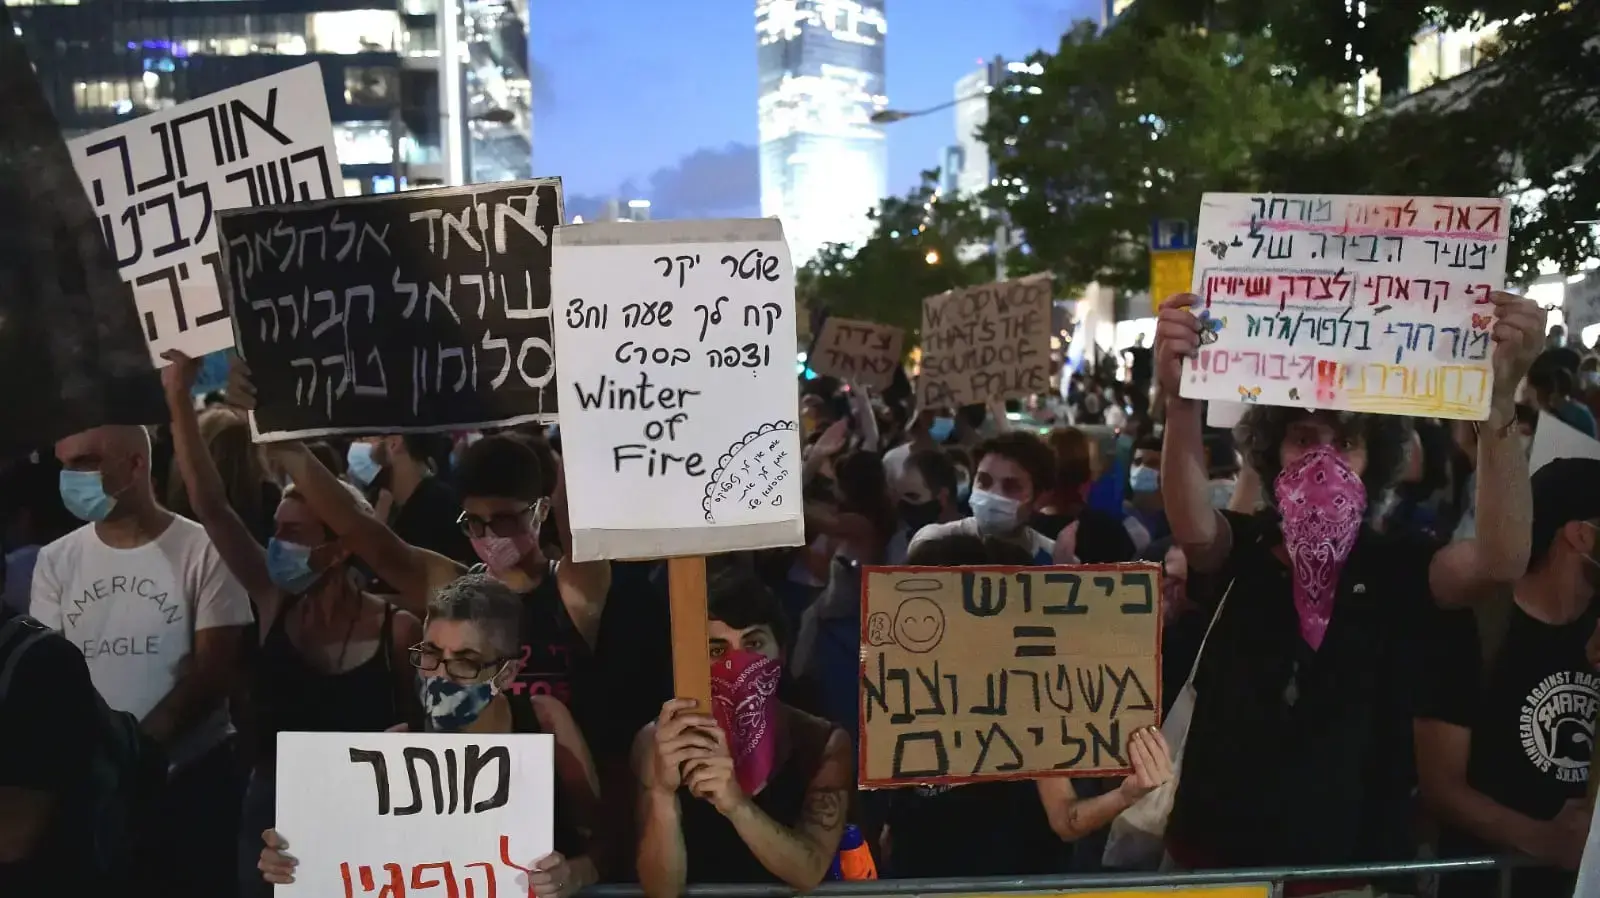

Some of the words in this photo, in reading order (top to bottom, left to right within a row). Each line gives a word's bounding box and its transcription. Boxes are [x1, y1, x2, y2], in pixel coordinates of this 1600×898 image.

[86, 87, 294, 206] אוחנה
[1251, 197, 1332, 228] מורחק
[1433, 204, 1502, 232] גאה
[230, 209, 391, 302] אלחלאק
[1309, 232, 1403, 262] הבירה
[654, 254, 701, 288] יקר
[1278, 267, 1351, 311] לצדק
[393, 265, 552, 325] שיראל
[1364, 275, 1450, 313] קראתי
[1465, 284, 1492, 304] כי
[252, 284, 375, 343] חבורה
[566, 298, 607, 329] וחצי
[622, 301, 673, 328] שעה
[694, 296, 729, 342] לך
[744, 302, 782, 335] קח
[1000, 310, 1043, 338] THE
[924, 345, 997, 377] SOUND
[1000, 338, 1037, 364] OF
[290, 345, 388, 420] טקה
[575, 371, 702, 410] Winter
[970, 366, 1045, 402] POLICE
[645, 413, 688, 441] of
[613, 444, 706, 477] Fire
[66, 576, 184, 628] AMERICAN
[961, 572, 1153, 617] כיבוש
[83, 635, 160, 659] EAGLE
[863, 652, 958, 724] וצבא
[1526, 671, 1571, 706] AGAINST
[892, 715, 1129, 778] אלימים
[1519, 705, 1551, 774] SKINHEADS
[349, 744, 511, 816] מותר
